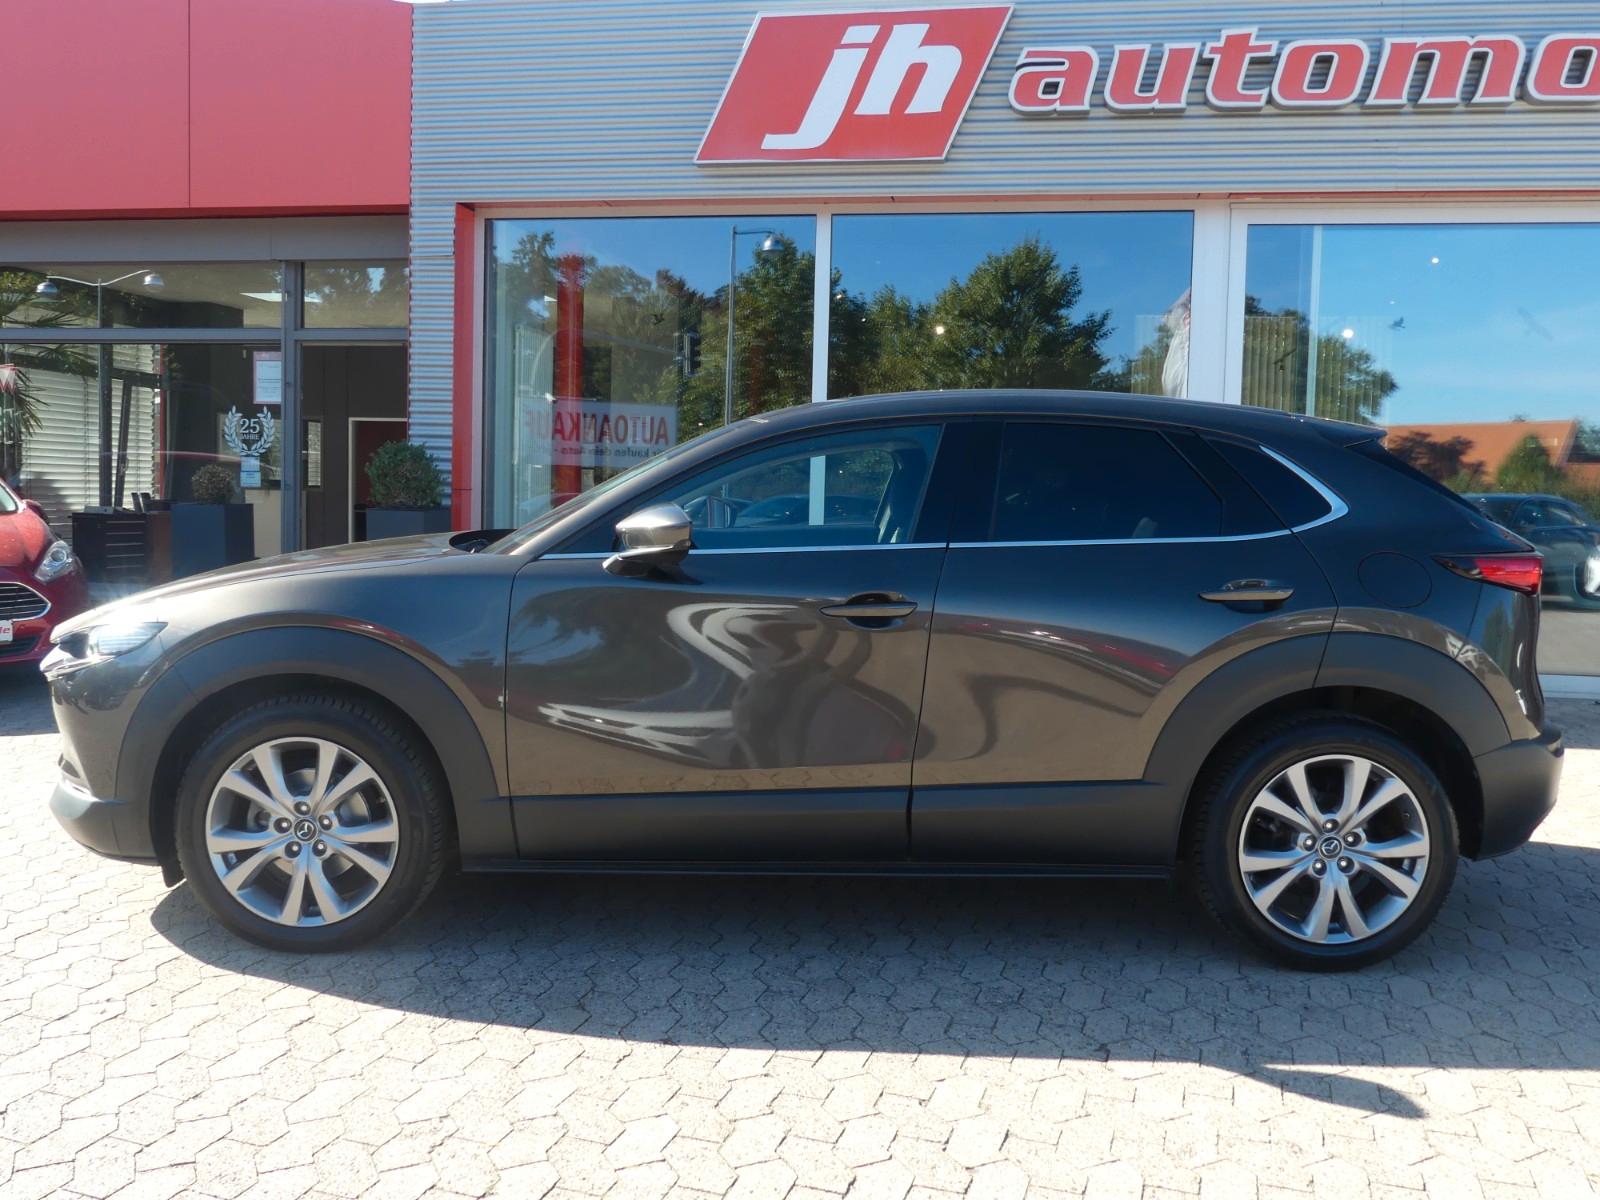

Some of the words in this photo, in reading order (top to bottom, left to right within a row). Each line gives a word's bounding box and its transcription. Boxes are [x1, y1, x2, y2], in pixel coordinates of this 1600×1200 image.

[760, 23, 963, 149] jh
[1008, 27, 1600, 112] automo
[239, 418, 260, 434] 25
